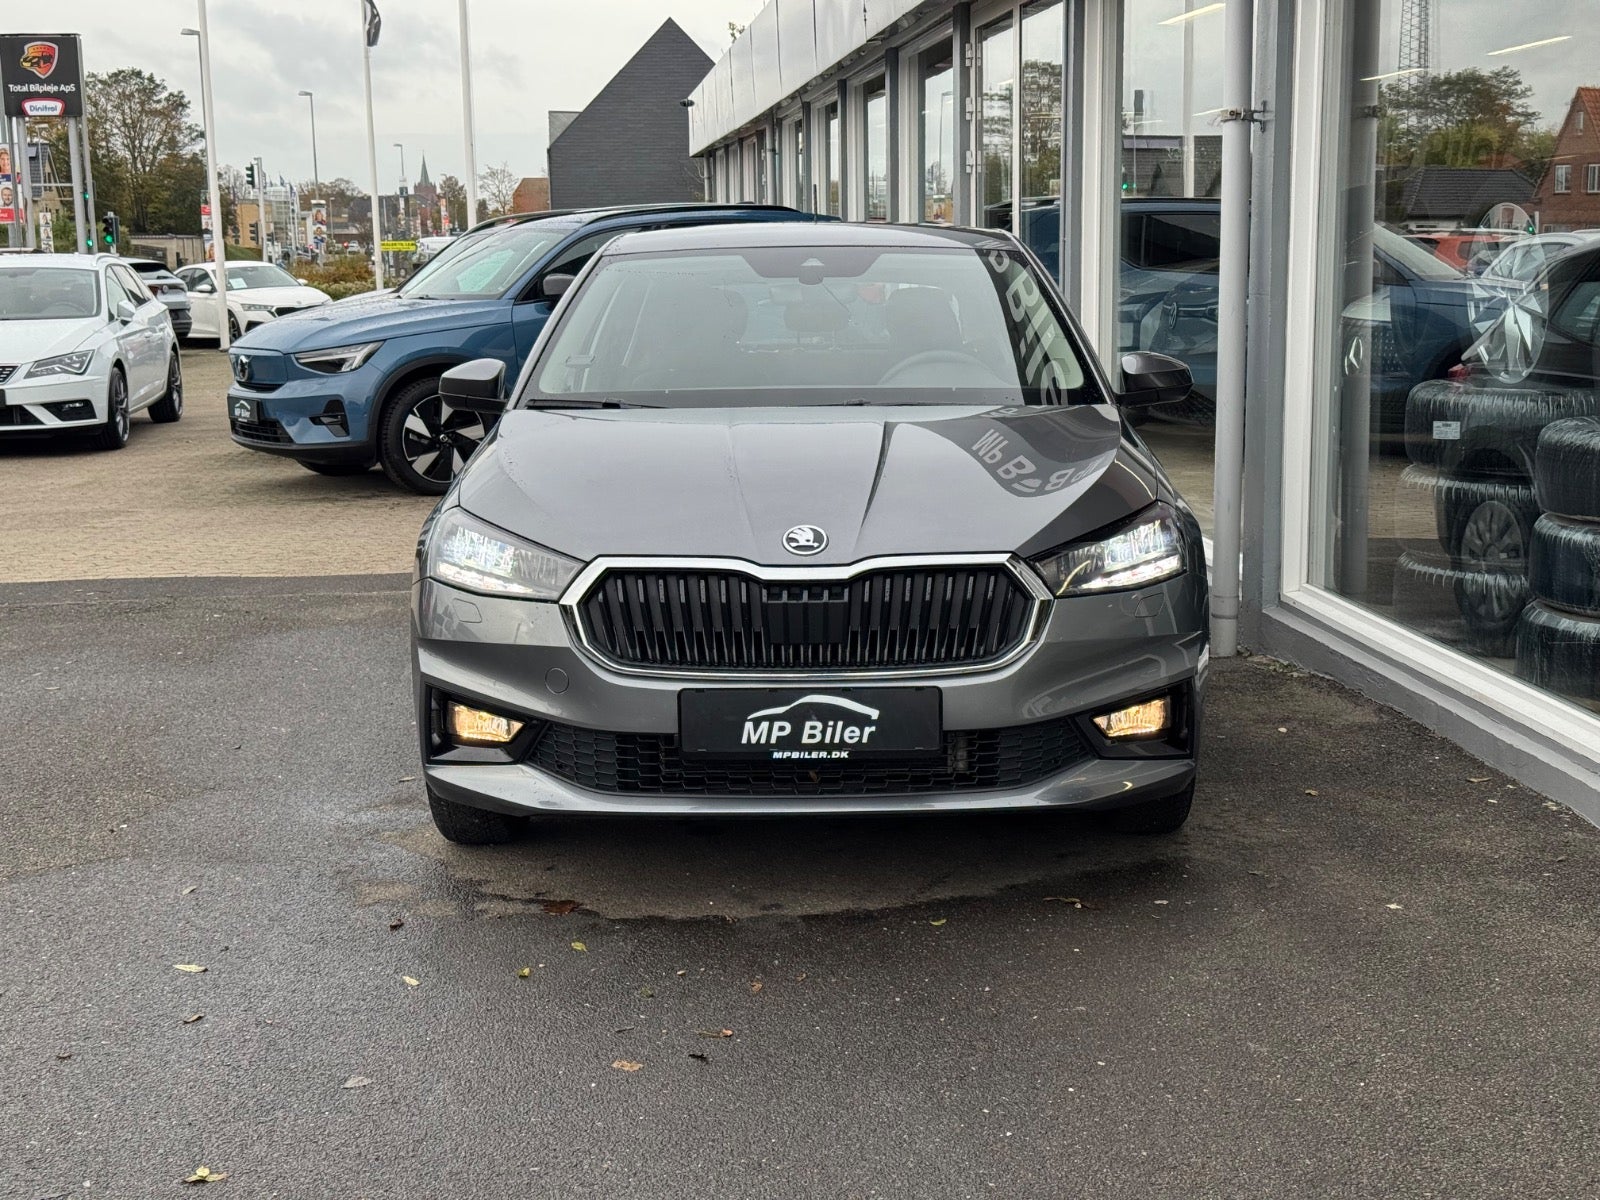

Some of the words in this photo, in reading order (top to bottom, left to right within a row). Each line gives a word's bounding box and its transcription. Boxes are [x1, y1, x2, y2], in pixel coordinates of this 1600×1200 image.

[8, 84, 29, 92] Total
[29, 84, 58, 93] Bilpleje
[60, 84, 76, 93] ApS
[741, 721, 791, 744] MP
[801, 720, 876, 744] Biler
[772, 750, 849, 759] MPBILER.DK
